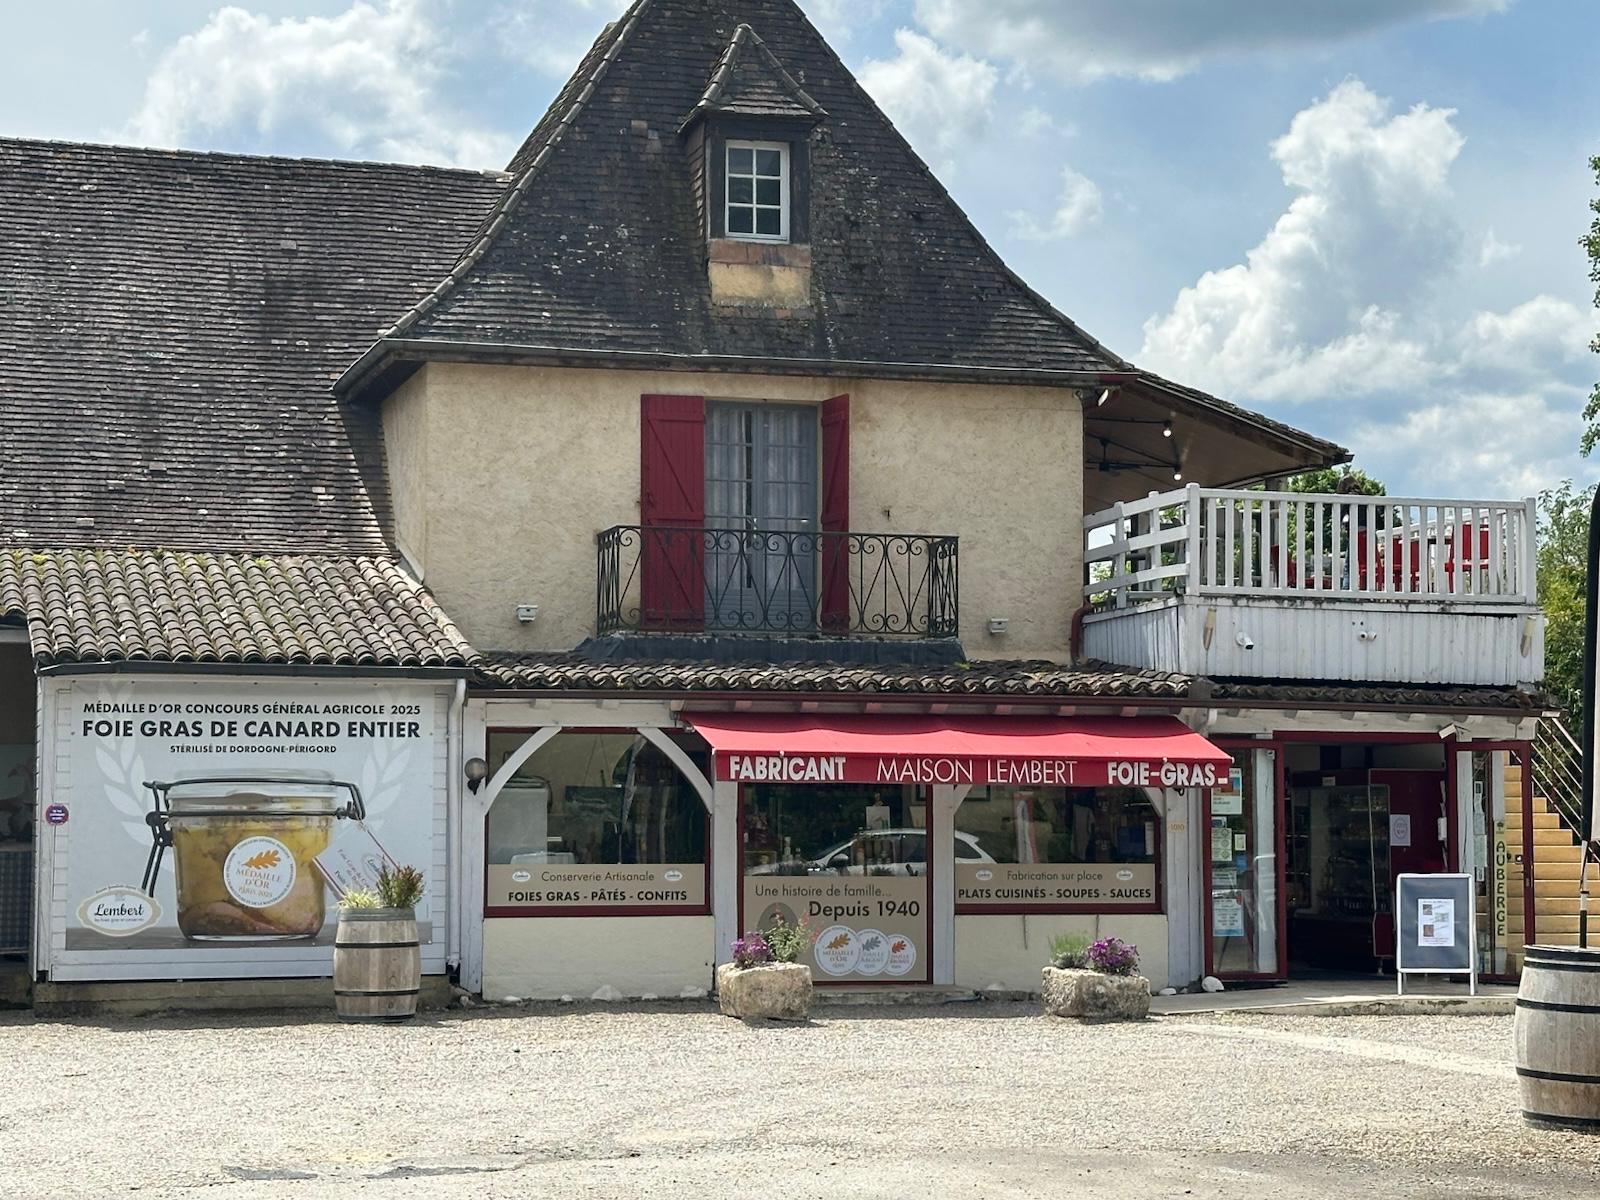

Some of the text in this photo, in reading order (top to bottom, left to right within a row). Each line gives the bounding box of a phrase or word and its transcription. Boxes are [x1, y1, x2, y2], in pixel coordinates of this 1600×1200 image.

[83, 700, 145, 713] MÉDAILLE
[185, 703, 259, 714] CONCOURS
[262, 701, 320, 715] GÉNÉRAL
[322, 704, 385, 715] AGRICOLE
[391, 705, 421, 715] 2025
[82, 720, 420, 738] FOIE GRAS DE CANARD ENTIER
[170, 743, 213, 753] STÉRILISÉ
[215, 745, 227, 753] DE
[729, 755, 846, 781] FABRICANT
[876, 757, 973, 783] MAISON
[986, 758, 1078, 785] LEMBERT
[541, 870, 601, 882] Conserverie
[604, 870, 655, 882] Artisanale
[1007, 870, 1103, 883] Fabrication sur place
[508, 891, 542, 902] FOIES
[546, 891, 580, 901] GRAS
[591, 888, 626, 901] PÂTÉS
[637, 890, 687, 901] CONFITS
[755, 885, 779, 897] Une
[782, 884, 823, 897] histoire
[826, 884, 841, 897] de
[958, 888, 991, 898] PLATS
[995, 886, 1046, 898] CUISINÉS
[1056, 888, 1100, 898] SOUPES
[1109, 888, 1151, 898] SAUCES
[1496, 841, 1506, 936] AUBERGE
[94, 903, 145, 916] Lembert
[809, 901, 920, 921] Depuis 1940
